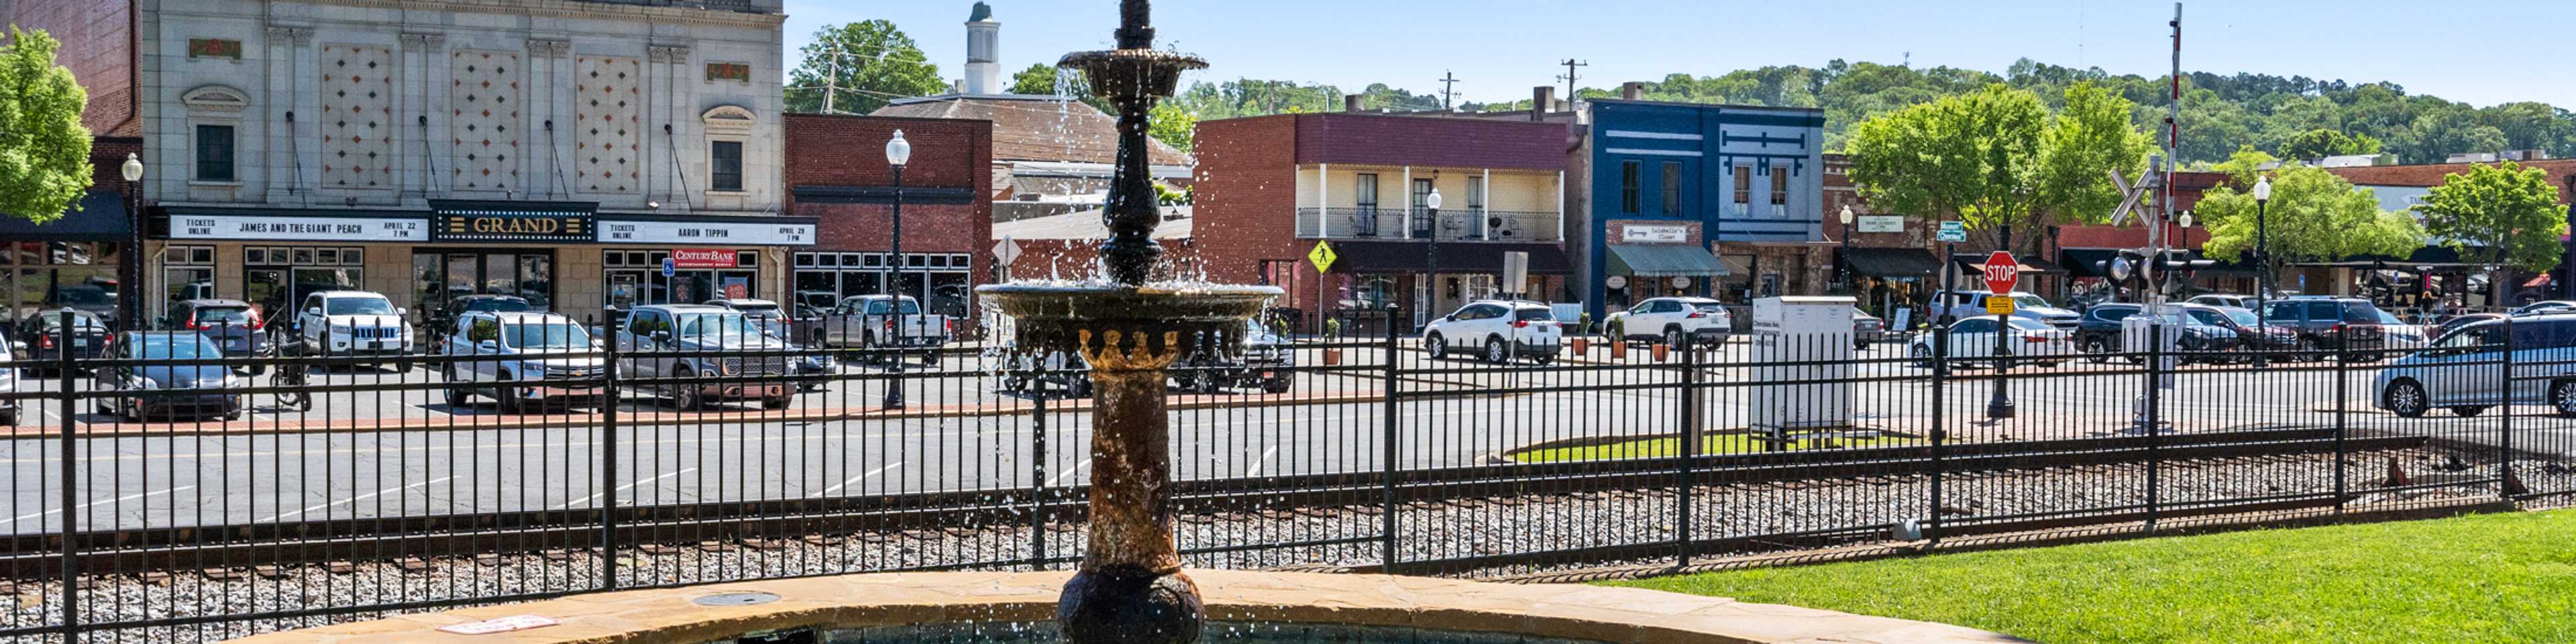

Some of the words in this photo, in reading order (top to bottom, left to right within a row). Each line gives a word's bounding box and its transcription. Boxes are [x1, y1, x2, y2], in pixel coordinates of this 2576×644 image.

[186, 219, 215, 227] TICKETS
[239, 223, 267, 232] JAMES
[270, 223, 286, 233] AND
[290, 224, 305, 233] THE
[307, 224, 331, 233] GIANT
[337, 225, 362, 233] PEACH
[474, 217, 558, 233] GRAND
[678, 229, 700, 237] AARON
[705, 229, 729, 237] TIPPIN
[1987, 265, 2015, 281] STOP
